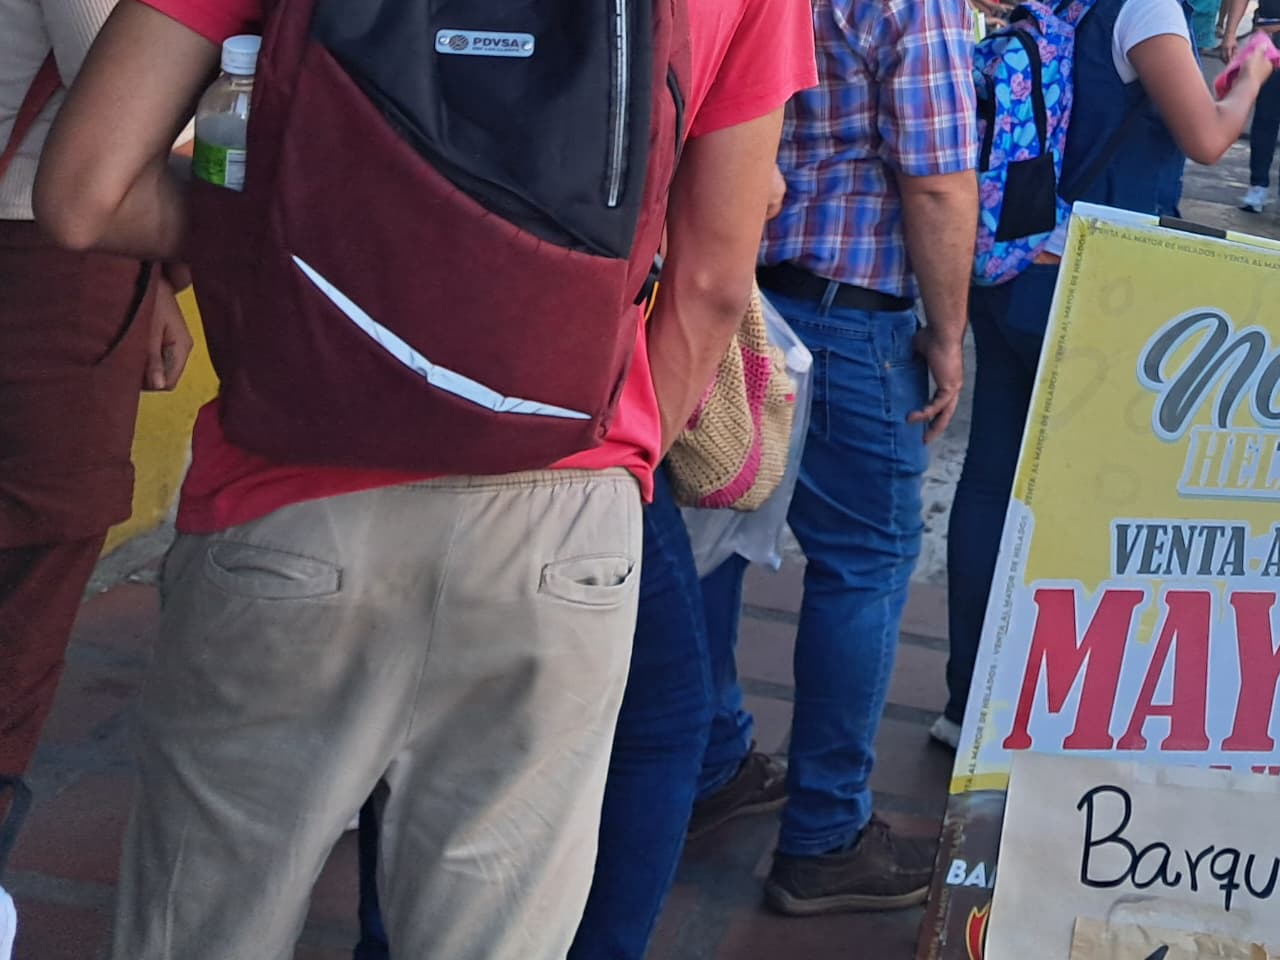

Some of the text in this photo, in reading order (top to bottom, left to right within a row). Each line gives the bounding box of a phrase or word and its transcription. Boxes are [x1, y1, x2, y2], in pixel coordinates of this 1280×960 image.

[473, 37, 520, 48] PDVSA
[1133, 235, 1162, 247] MAYOR
[1164, 241, 1175, 249] DE
[1177, 243, 1215, 257] HELADOS
[1223, 253, 1250, 264] VENTA
[1251, 258, 1262, 267] AL
[1064, 288, 1075, 318] MAYOR
[1055, 333, 1066, 362] VENTA
[1044, 371, 1058, 412] HELADOS
[1041, 414, 1049, 426] DE
[1034, 428, 1046, 460] MAYOR
[1031, 461, 1039, 474] AL
[1013, 514, 1028, 558] HELADOS
[1114, 523, 1247, 577] VENTA
[1011, 560, 1018, 572] DE
[982, 664, 997, 708] HELADOS
[979, 711, 987, 723] DE
[971, 724, 984, 760] MAYOR
[946, 858, 998, 889] BA
